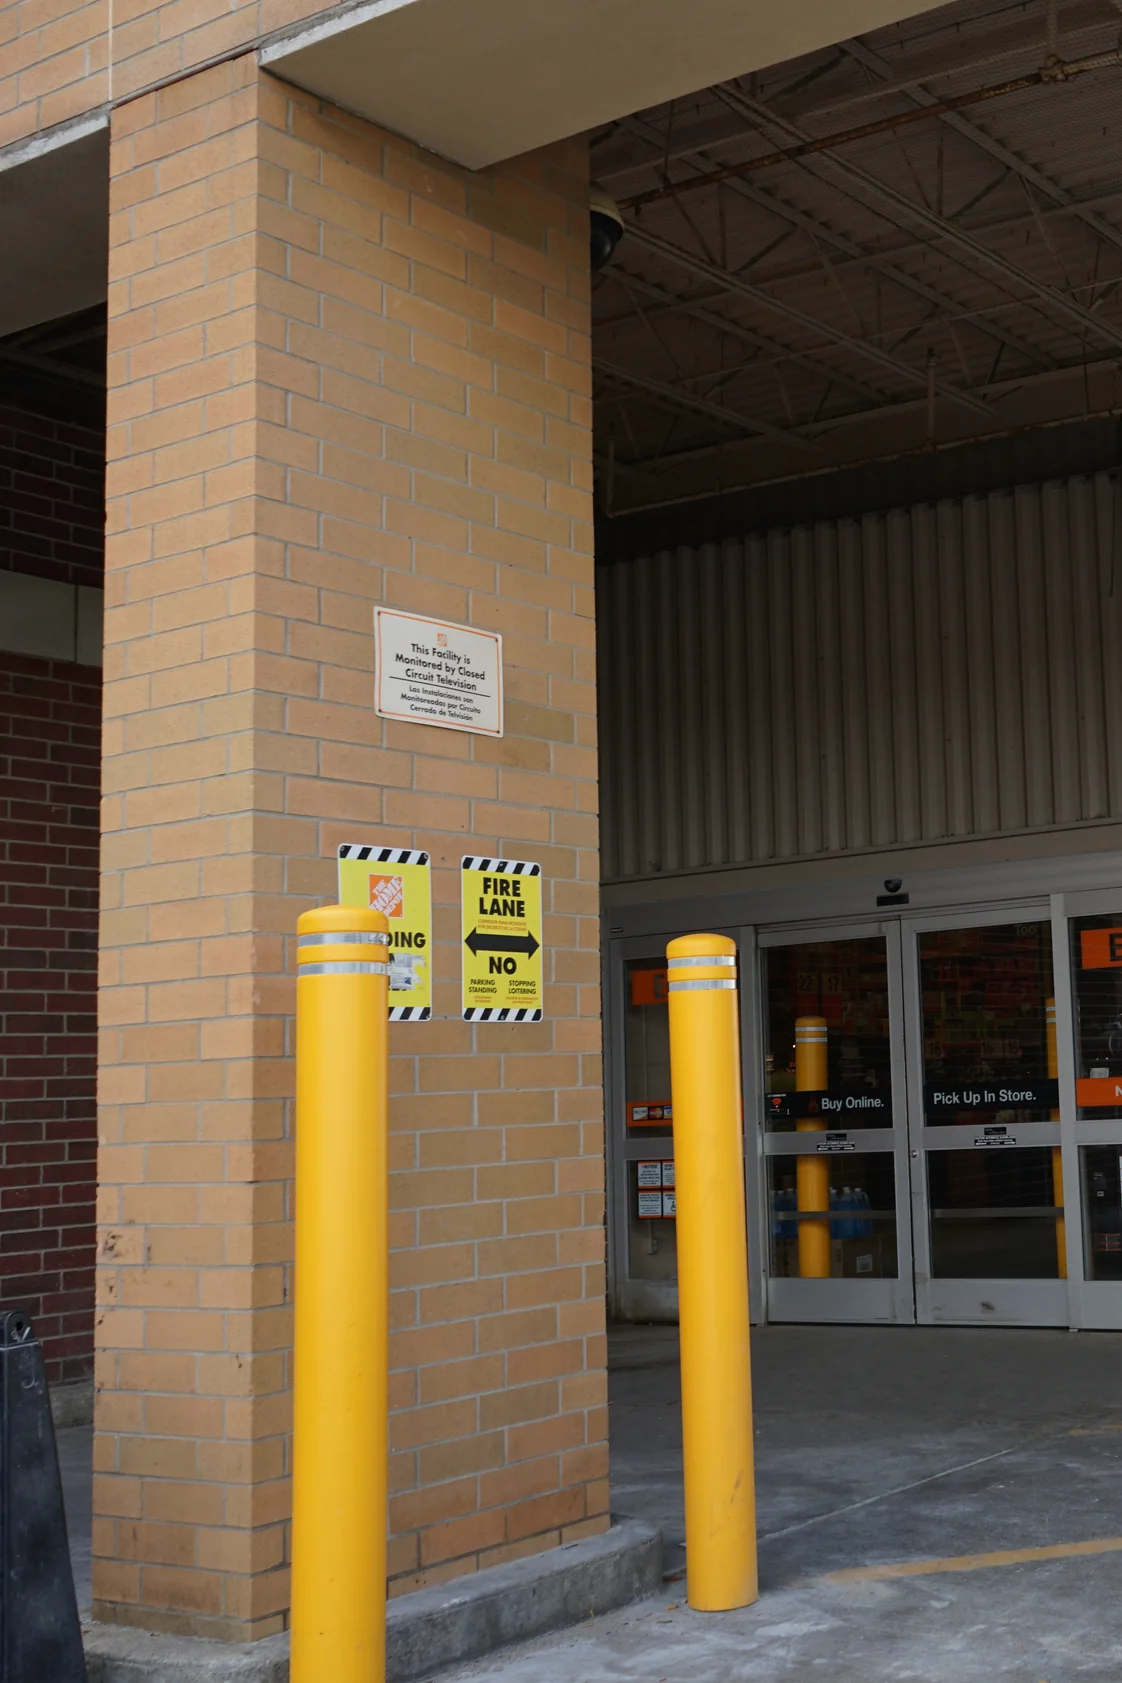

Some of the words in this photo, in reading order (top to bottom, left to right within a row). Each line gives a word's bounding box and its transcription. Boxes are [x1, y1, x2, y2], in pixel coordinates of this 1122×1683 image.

[411, 643, 429, 655] This
[432, 648, 462, 664] Facility
[464, 655, 471, 665] is
[395, 653, 443, 671] Monitored
[445, 663, 456, 676] by
[458, 667, 486, 680] Closed
[405, 668, 434, 682] Circuit
[436, 674, 477, 691] Television
[401, 693, 446, 707] Monitoreadas
[447, 702, 458, 710] por
[459, 704, 481, 714] Circuito
[409, 685, 420, 693] Las
[422, 687, 462, 701] Instalaciones
[463, 696, 474, 704] son
[410, 704, 437, 714] Cerrado
[439, 709, 446, 717] de
[369, 876, 404, 912] HOME
[371, 879, 387, 896] THE
[483, 877, 521, 897] FIRE
[479, 897, 526, 918] LANE
[489, 956, 517, 975] NO
[468, 986, 497, 994] STANDING
[508, 987, 536, 995] LOITERING
[821, 1098, 843, 1111] Buy
[845, 1096, 885, 1108] Online.
[933, 1092, 960, 1105] Pick
[963, 1091, 981, 1106] Up
[984, 1090, 996, 1103] In
[999, 1089, 1037, 1102] Store.
